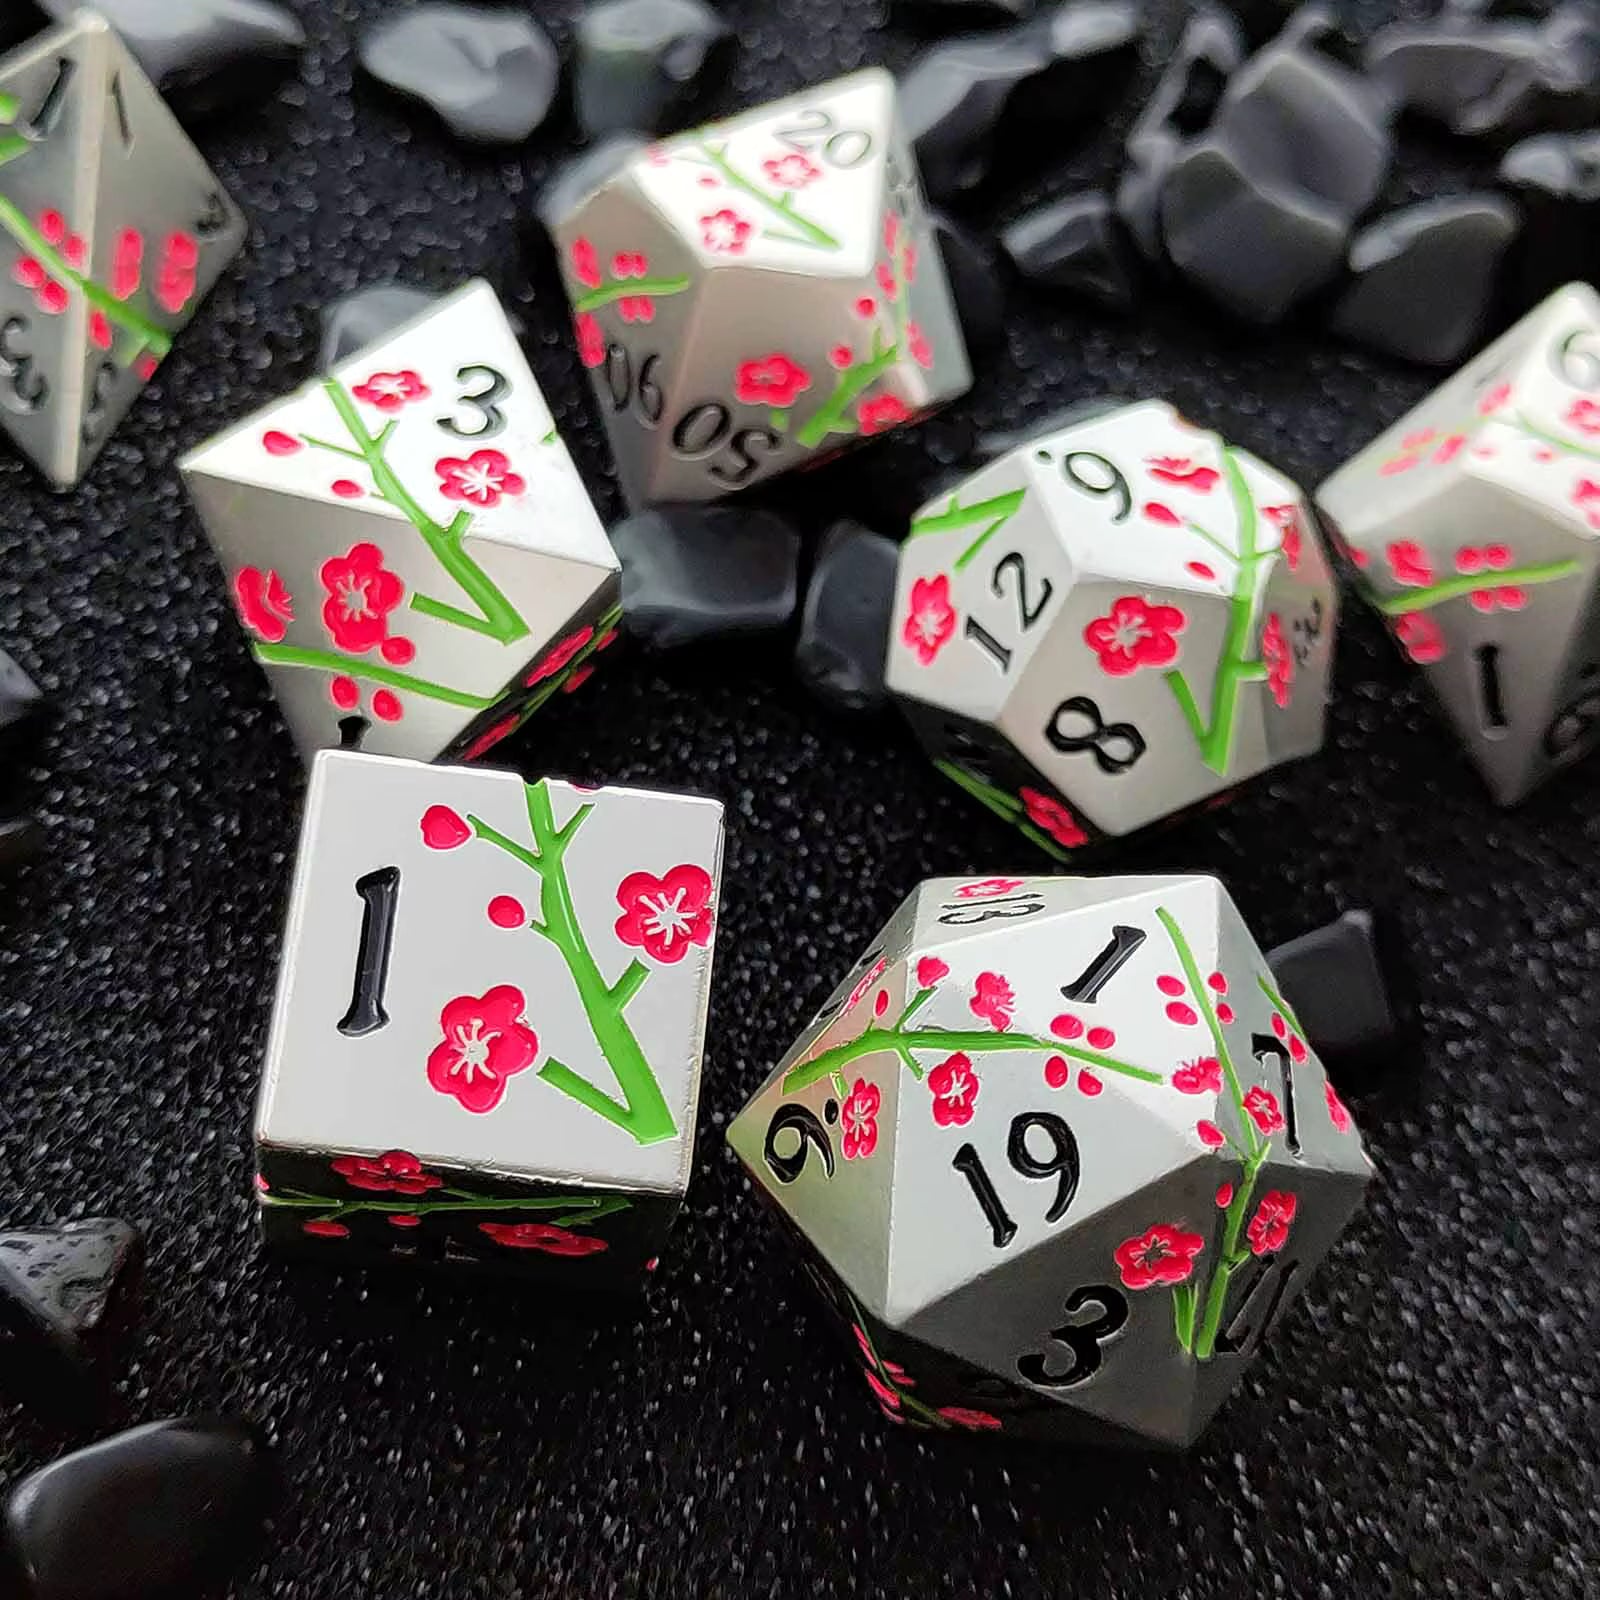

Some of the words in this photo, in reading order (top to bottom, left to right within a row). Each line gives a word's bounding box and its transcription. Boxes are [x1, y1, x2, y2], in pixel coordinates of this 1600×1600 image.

[773, 110, 872, 168] 20
[435, 364, 513, 440] 3
[672, 402, 781, 490] 50
[964, 551, 1053, 674] 12
[1473, 642, 1509, 738] 1
[1045, 695, 1147, 775] 8
[336, 865, 402, 1037] 1
[938, 893, 1046, 925] 13
[1060, 925, 1147, 1004] 1
[952, 1111, 1082, 1249] 19
[1016, 1284, 1131, 1388] 3
